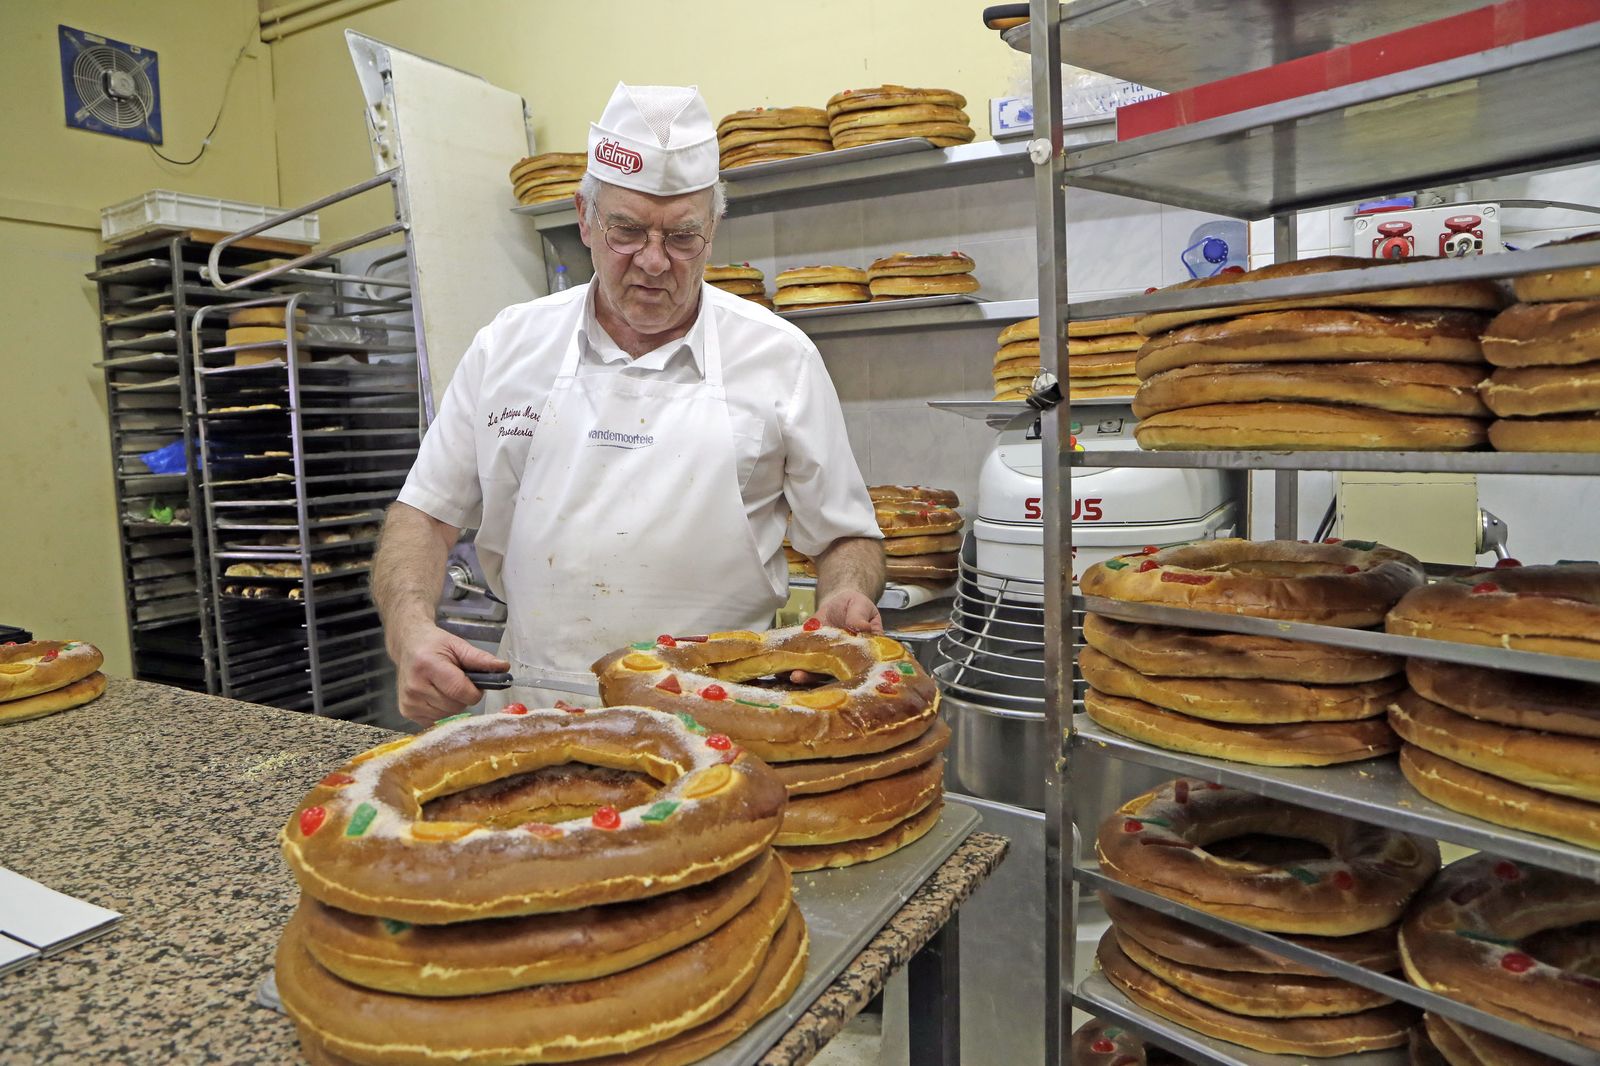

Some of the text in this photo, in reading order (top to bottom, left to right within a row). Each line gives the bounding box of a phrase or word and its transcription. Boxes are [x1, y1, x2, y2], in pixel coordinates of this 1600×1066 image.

[598, 137, 636, 175] Kelmy
[487, 412, 498, 427] La
[522, 405, 541, 422] Merc
[1025, 497, 1103, 521] SUS
